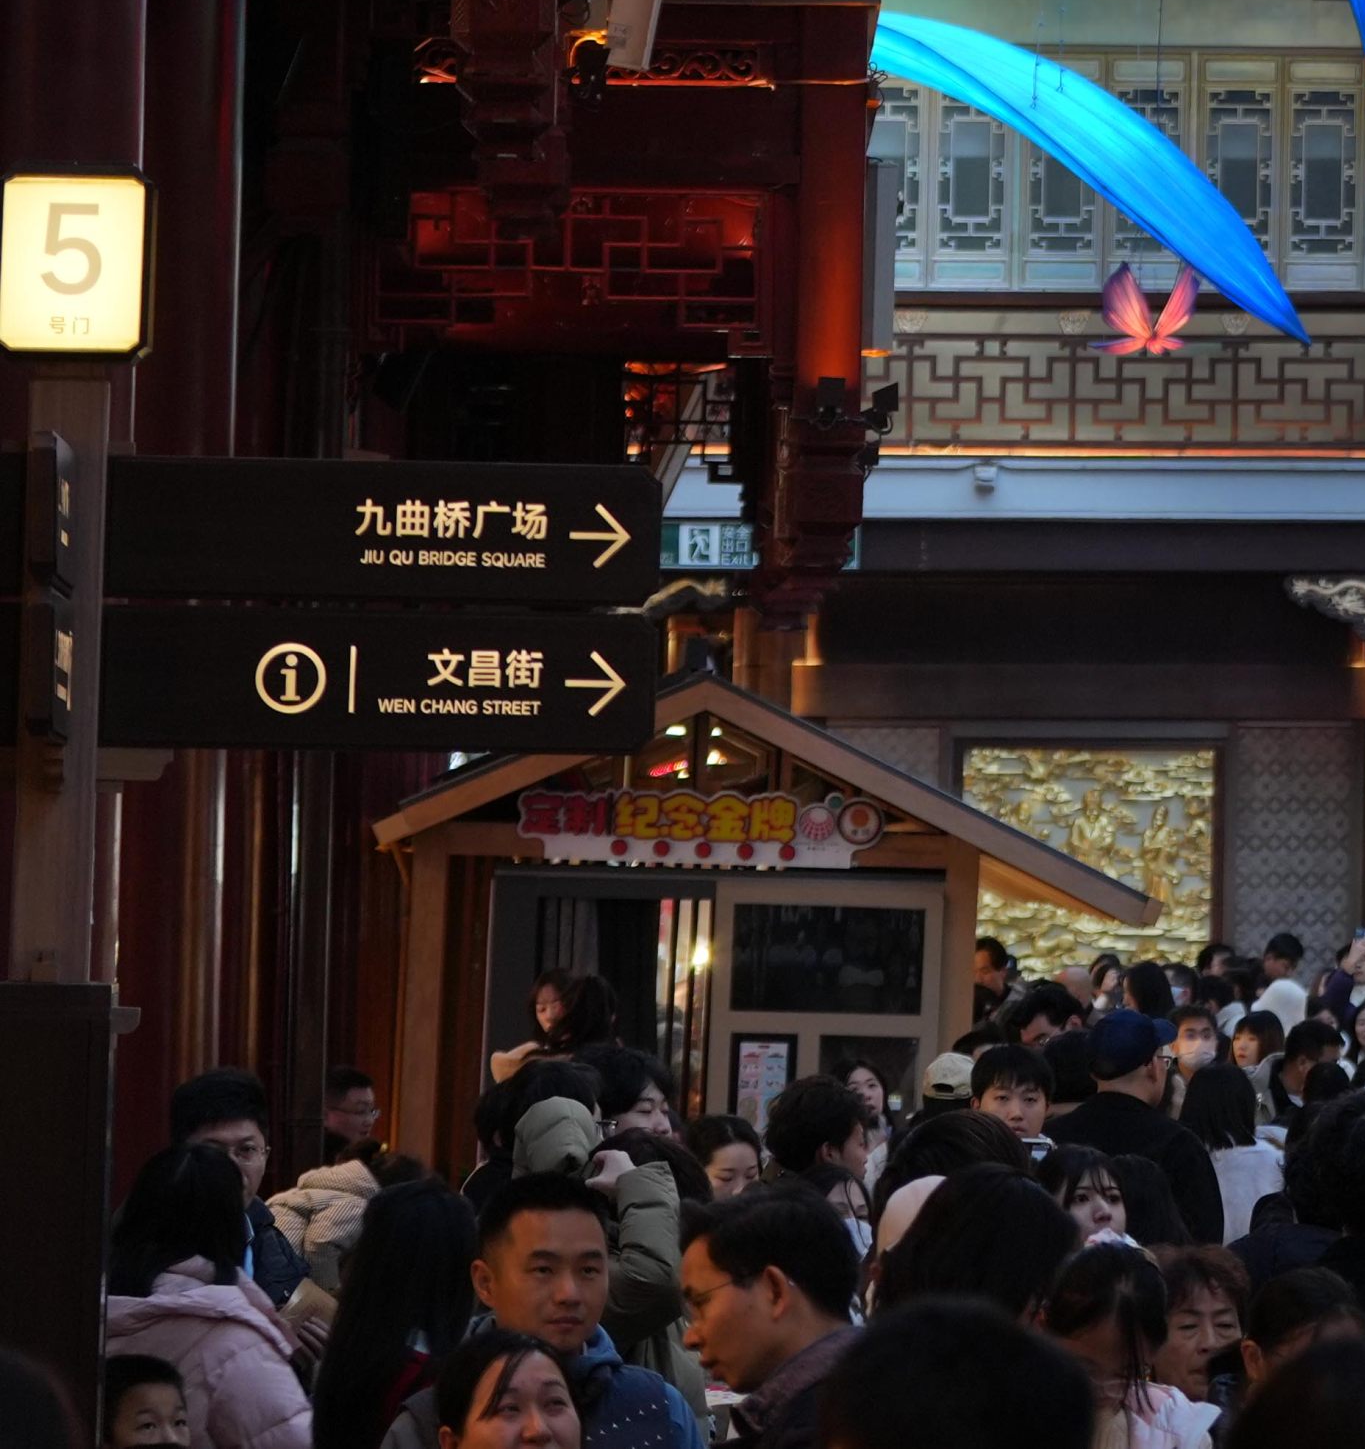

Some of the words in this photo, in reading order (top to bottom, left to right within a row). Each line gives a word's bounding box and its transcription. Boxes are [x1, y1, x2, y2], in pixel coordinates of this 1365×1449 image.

[40, 202, 102, 295] 5
[49, 316, 90, 334] 号门
[355, 498, 548, 540] 九曲桥广场
[721, 525, 751, 538] 安全
[721, 539, 748, 552] 出口
[360, 549, 384, 564] JIU
[389, 550, 413, 565] QU
[418, 551, 477, 567] BRIDGE
[481, 552, 546, 568] SQUARE
[427, 648, 543, 688] 文昌街
[378, 698, 415, 713] WEN
[420, 699, 478, 715] CHANG
[482, 700, 541, 716] STREET
